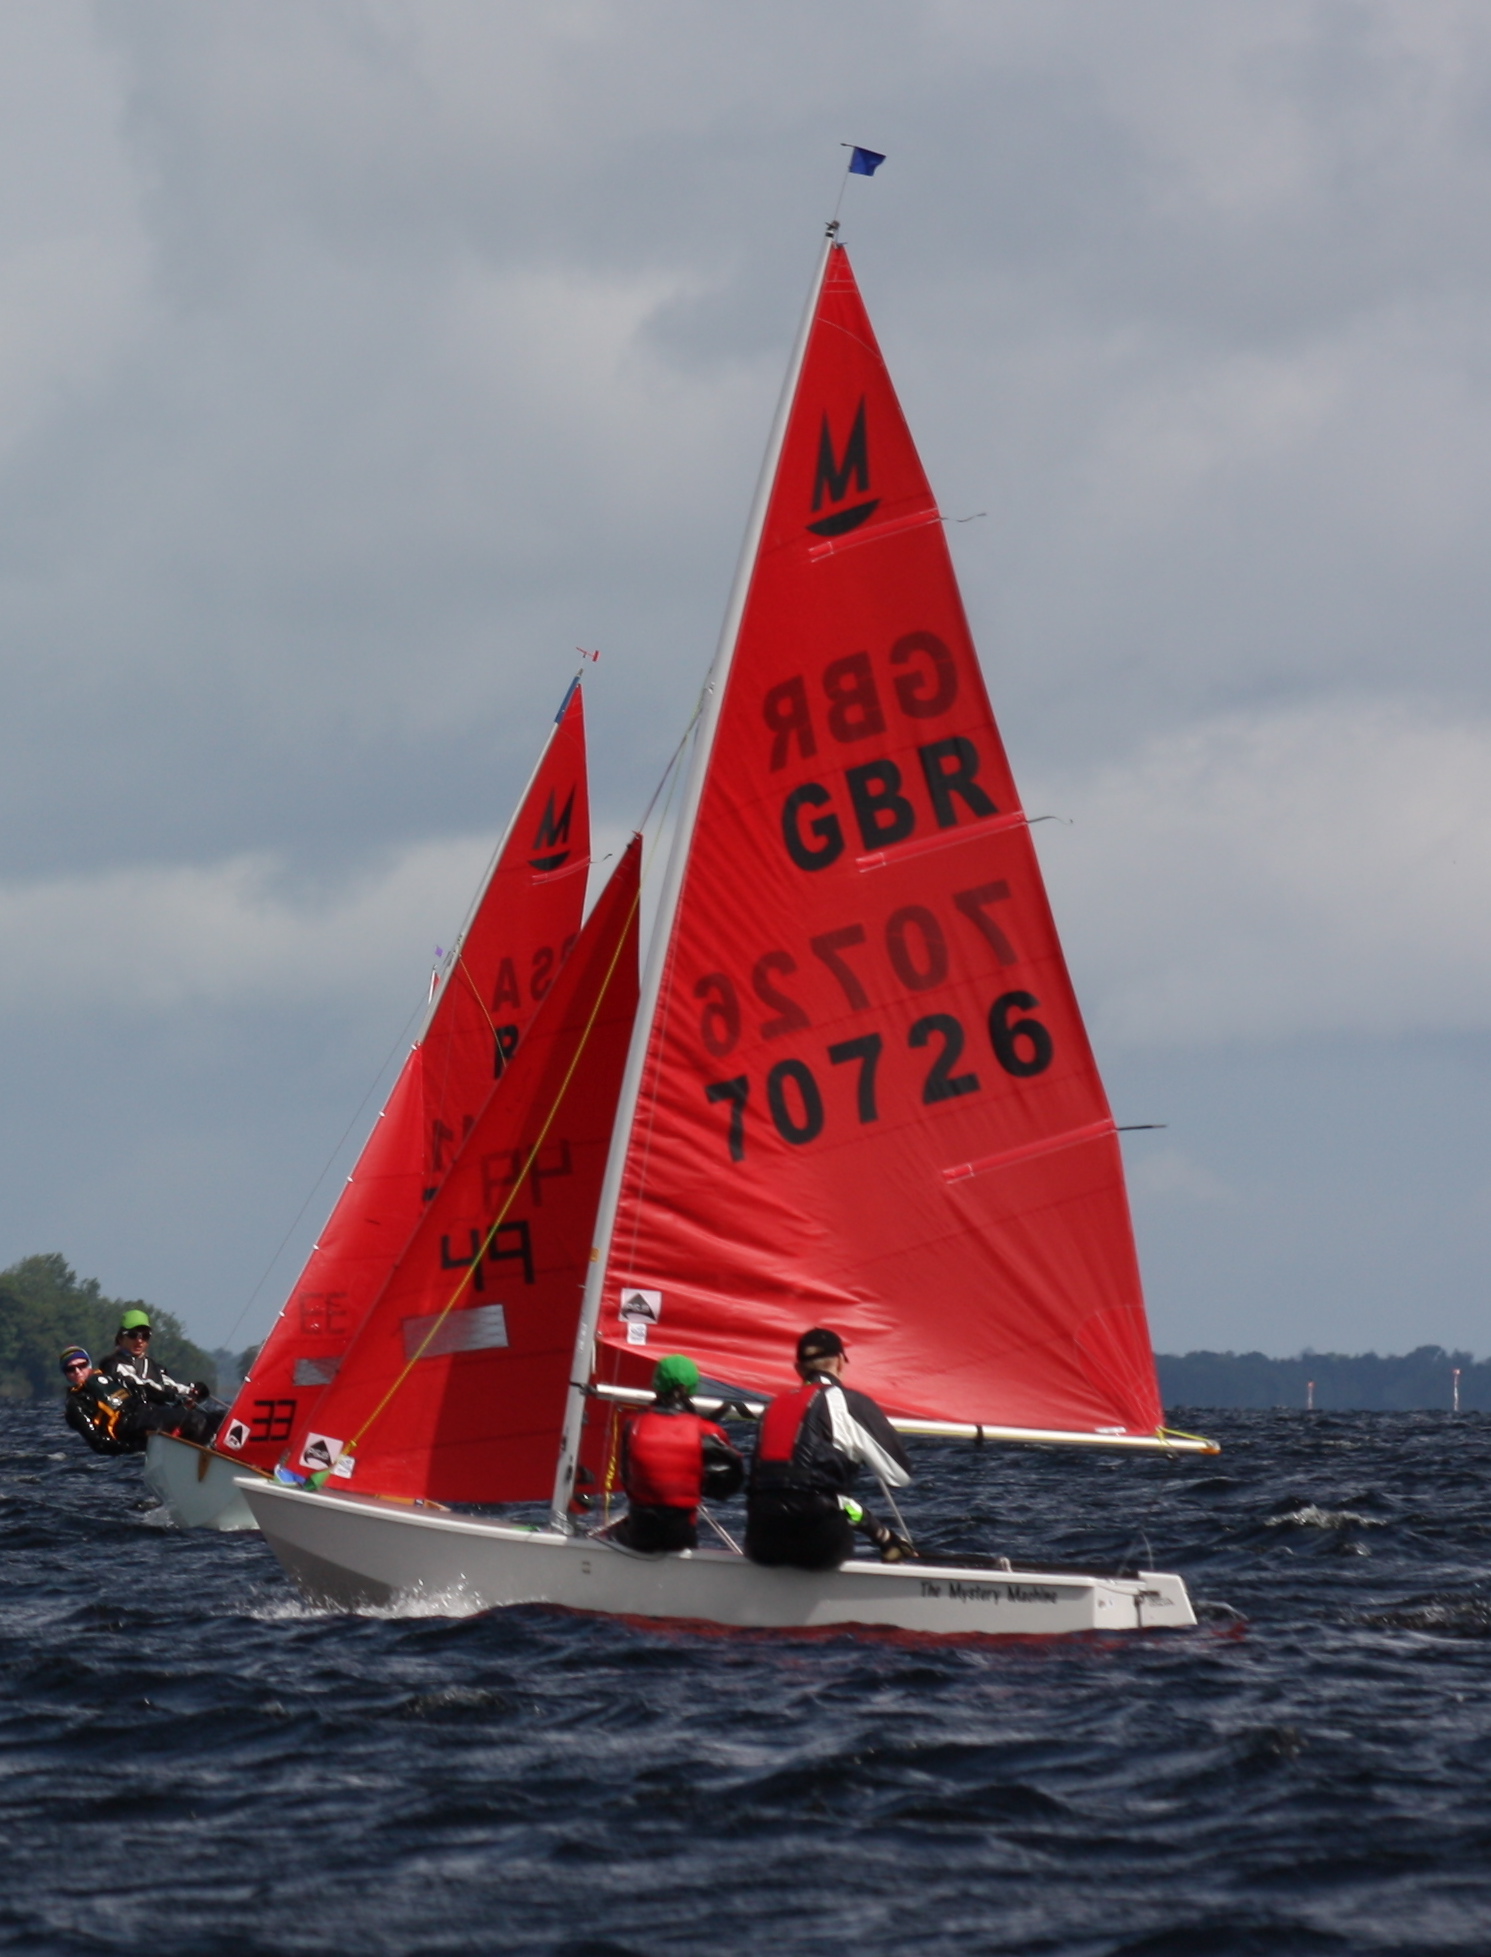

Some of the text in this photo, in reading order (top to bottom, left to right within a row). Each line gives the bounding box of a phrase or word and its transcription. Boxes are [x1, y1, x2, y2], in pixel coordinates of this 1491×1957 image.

[782, 735, 998, 872] GBR
[705, 990, 1054, 1162] 70726
[920, 1581, 1058, 1605] The Mystery Machine
